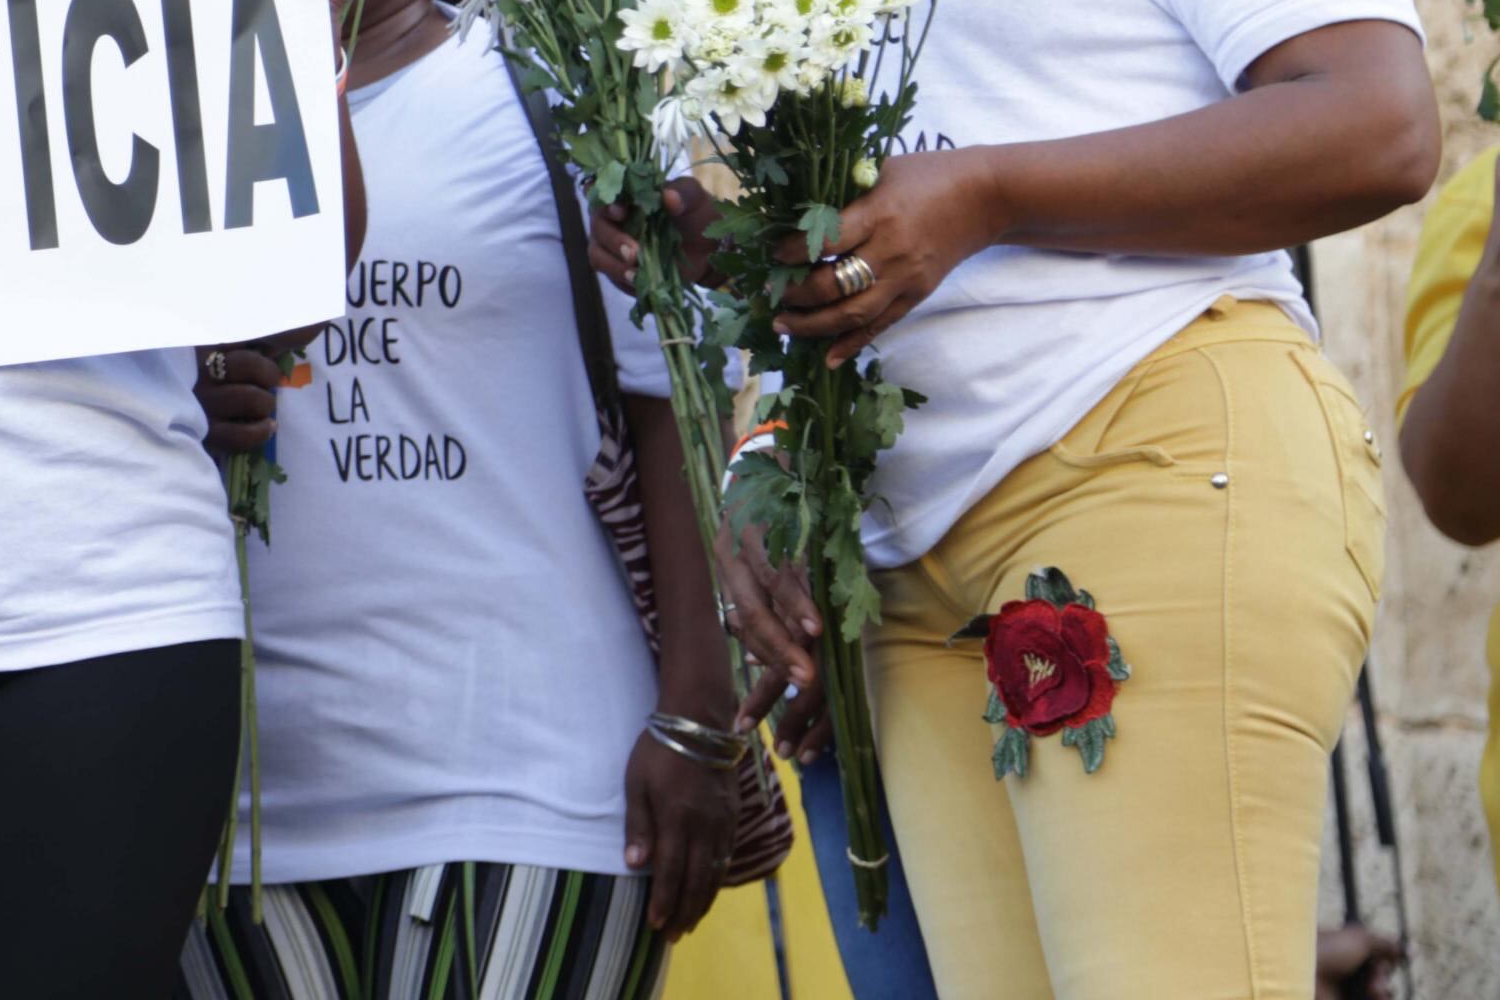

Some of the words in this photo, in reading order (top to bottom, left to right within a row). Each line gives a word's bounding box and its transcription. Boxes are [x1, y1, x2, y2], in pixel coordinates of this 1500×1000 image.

[346, 260, 462, 308] UERPO
[325, 317, 400, 366] DICE
[327, 376, 370, 424] LA
[330, 433, 467, 483] VERDAD
